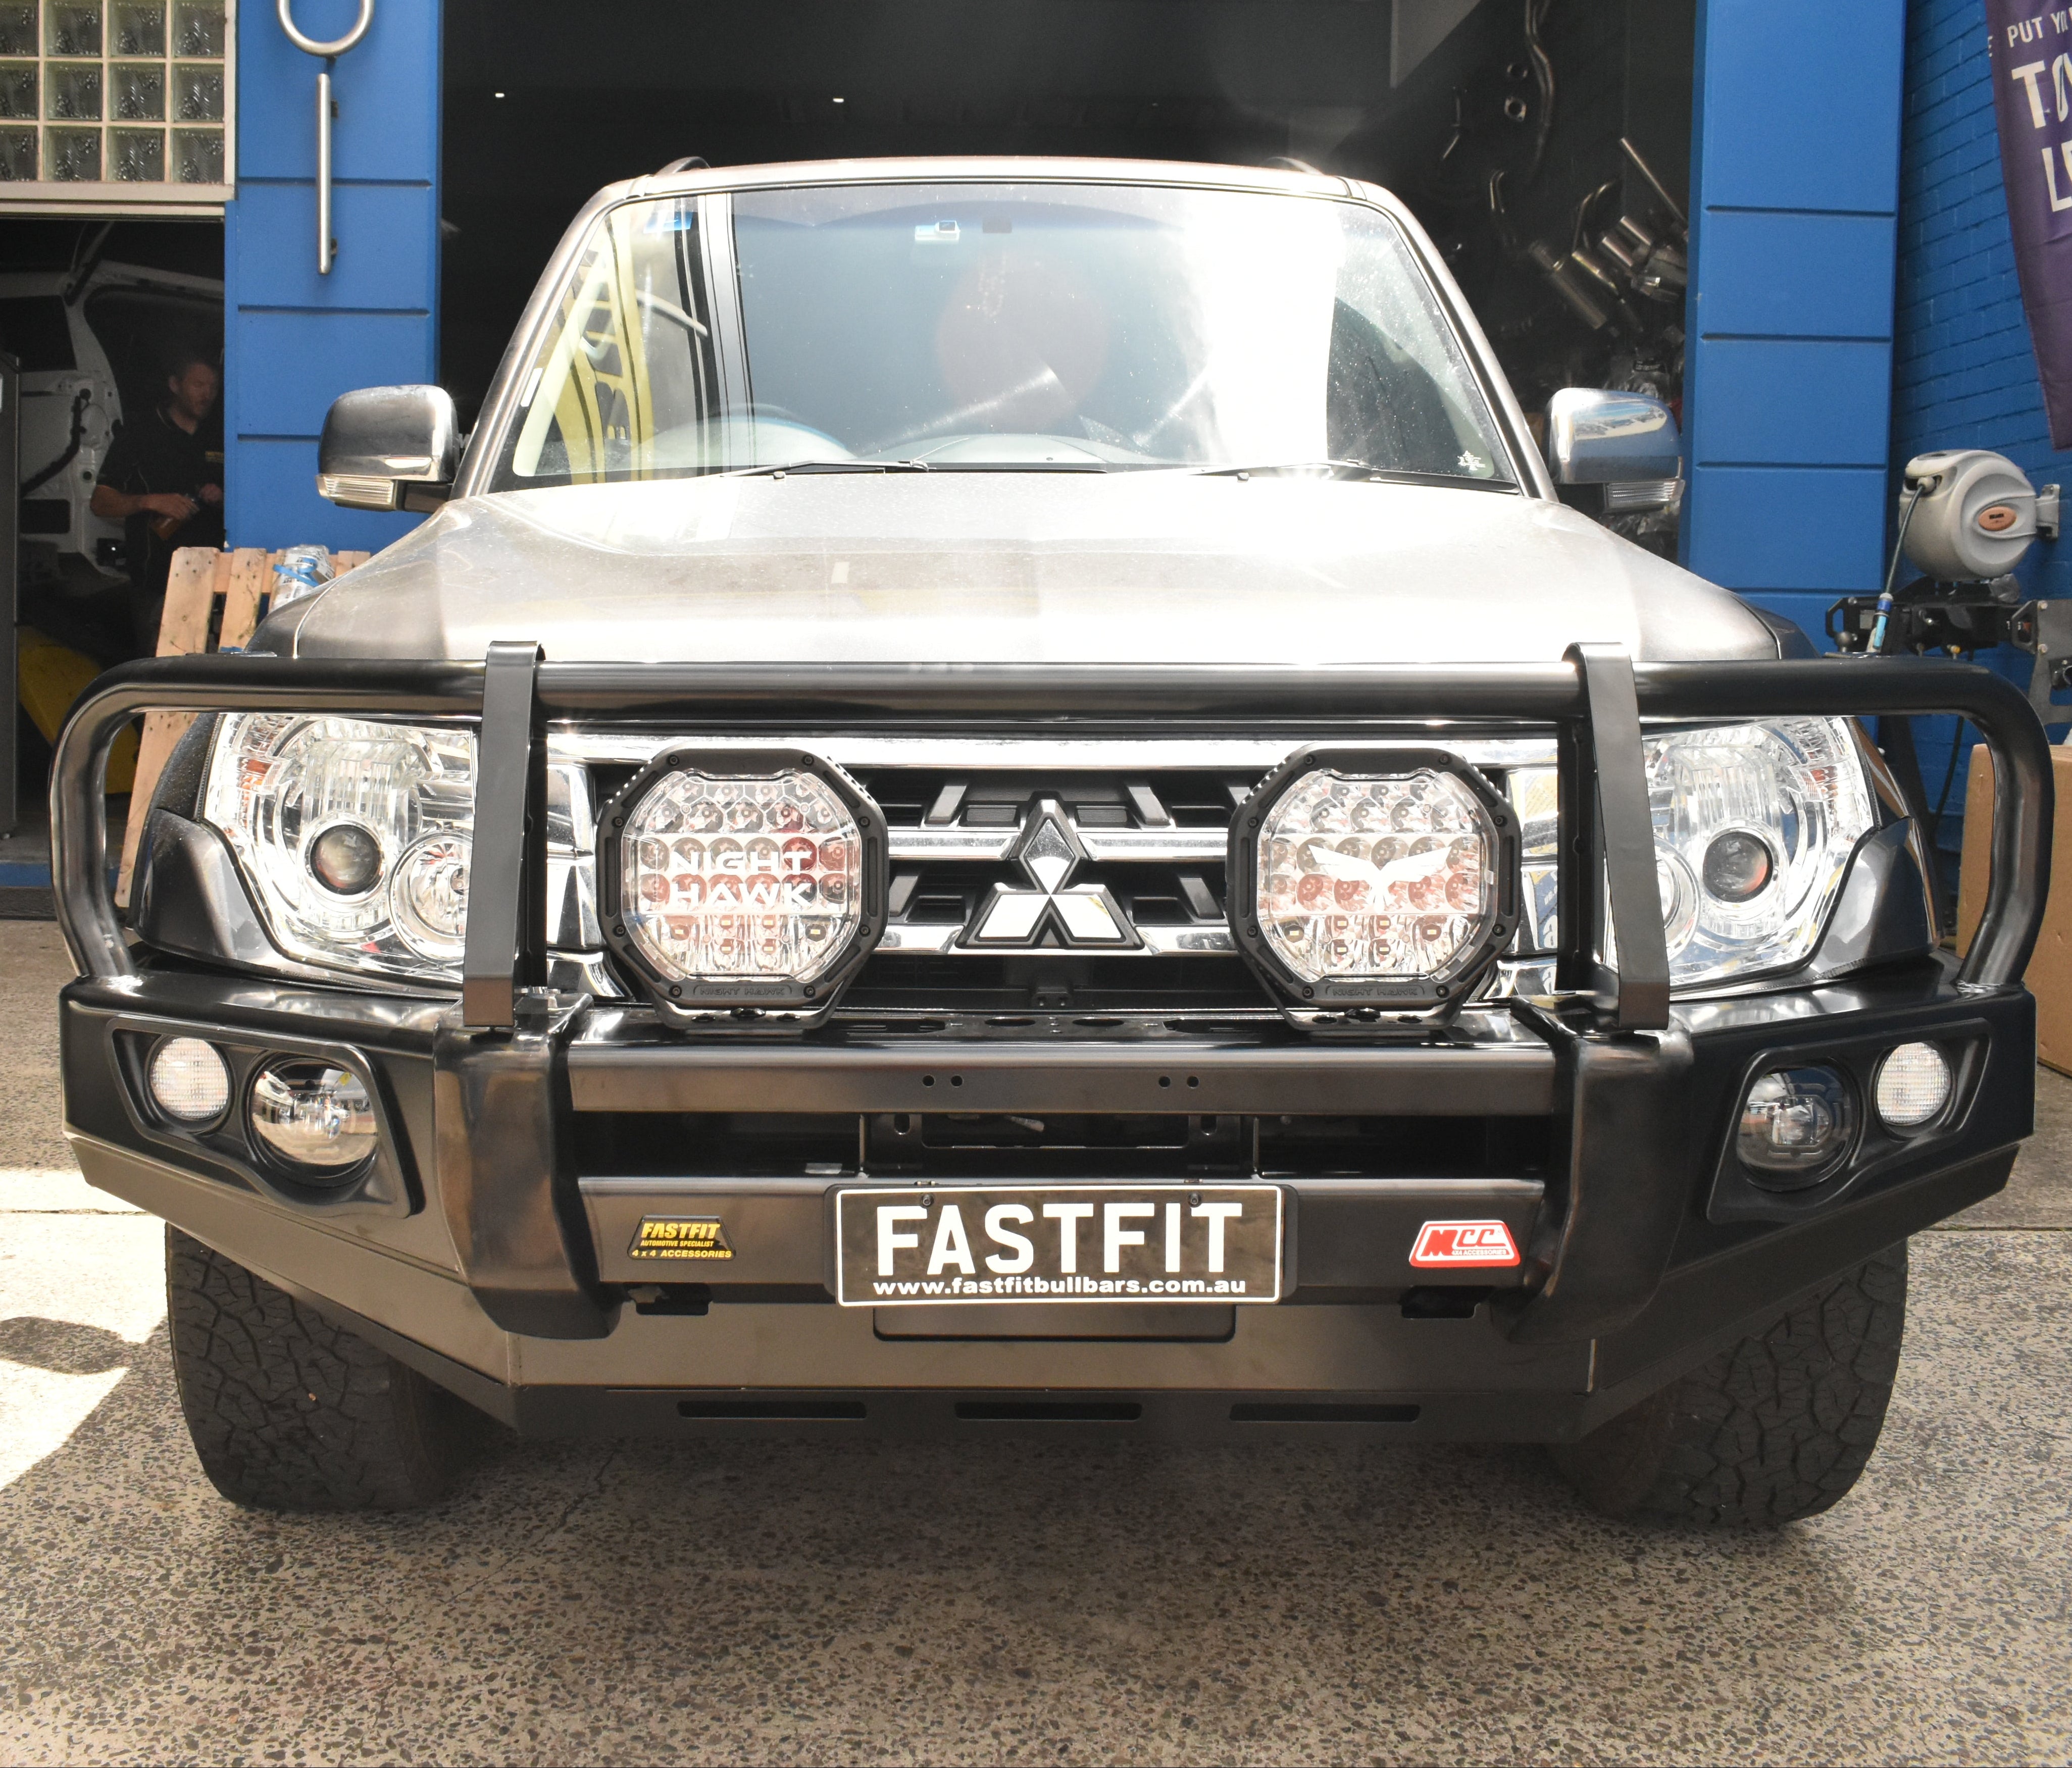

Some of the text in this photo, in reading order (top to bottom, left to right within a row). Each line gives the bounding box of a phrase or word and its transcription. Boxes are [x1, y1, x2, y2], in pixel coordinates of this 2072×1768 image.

[2007, 16, 2044, 48] PUT
[670, 851, 813, 875] NIGHT
[669, 883, 813, 907] HAWK
[700, 987, 785, 996] NIGHT HAWK
[1333, 988, 1418, 996] NIGHT HAWK
[641, 1223, 720, 1239] FASTFIT
[877, 1203, 1242, 1276] FASTFIT
[1421, 1229, 1506, 1256] MCC
[660, 1250, 732, 1258] ACCESSORIES
[873, 1275, 1246, 1295] www.fastfitbullbars.com.au
